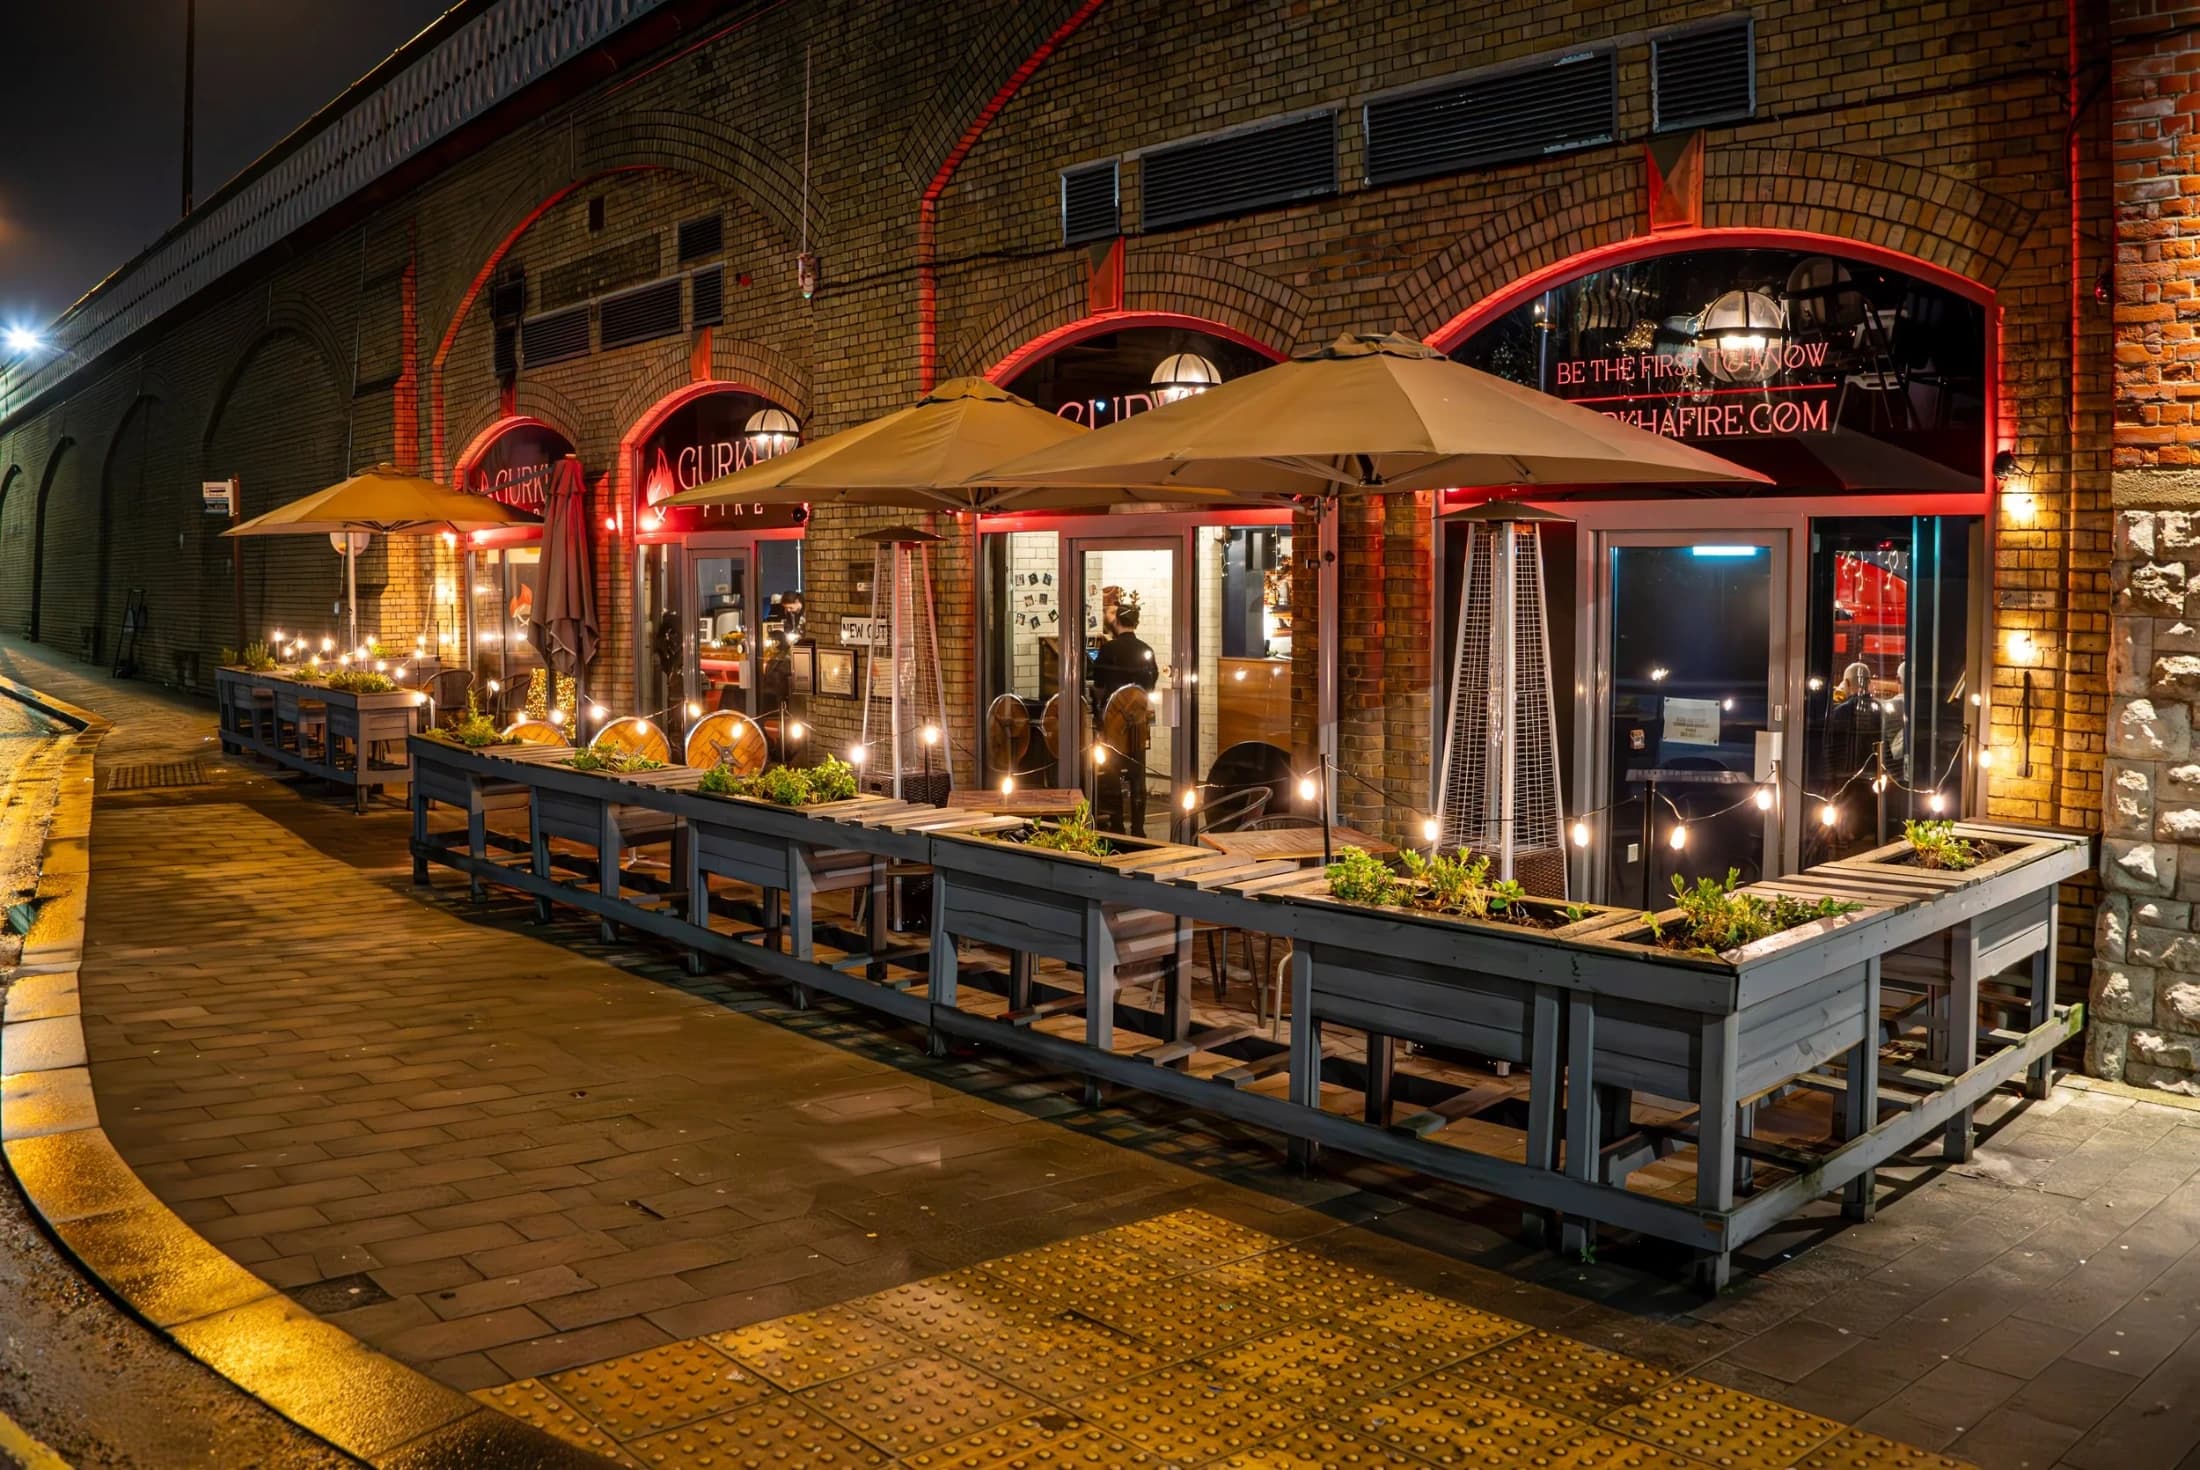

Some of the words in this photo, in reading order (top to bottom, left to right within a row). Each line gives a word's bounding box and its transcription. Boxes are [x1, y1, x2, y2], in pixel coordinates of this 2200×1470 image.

[1557, 361, 1585, 384] BE
[1590, 356, 1635, 383] THE
[1641, 347, 1700, 379] FIRST
[1708, 348, 1747, 374] TO
[1600, 400, 1828, 437] HAFIRE.COM
[842, 623, 863, 639] NEW
